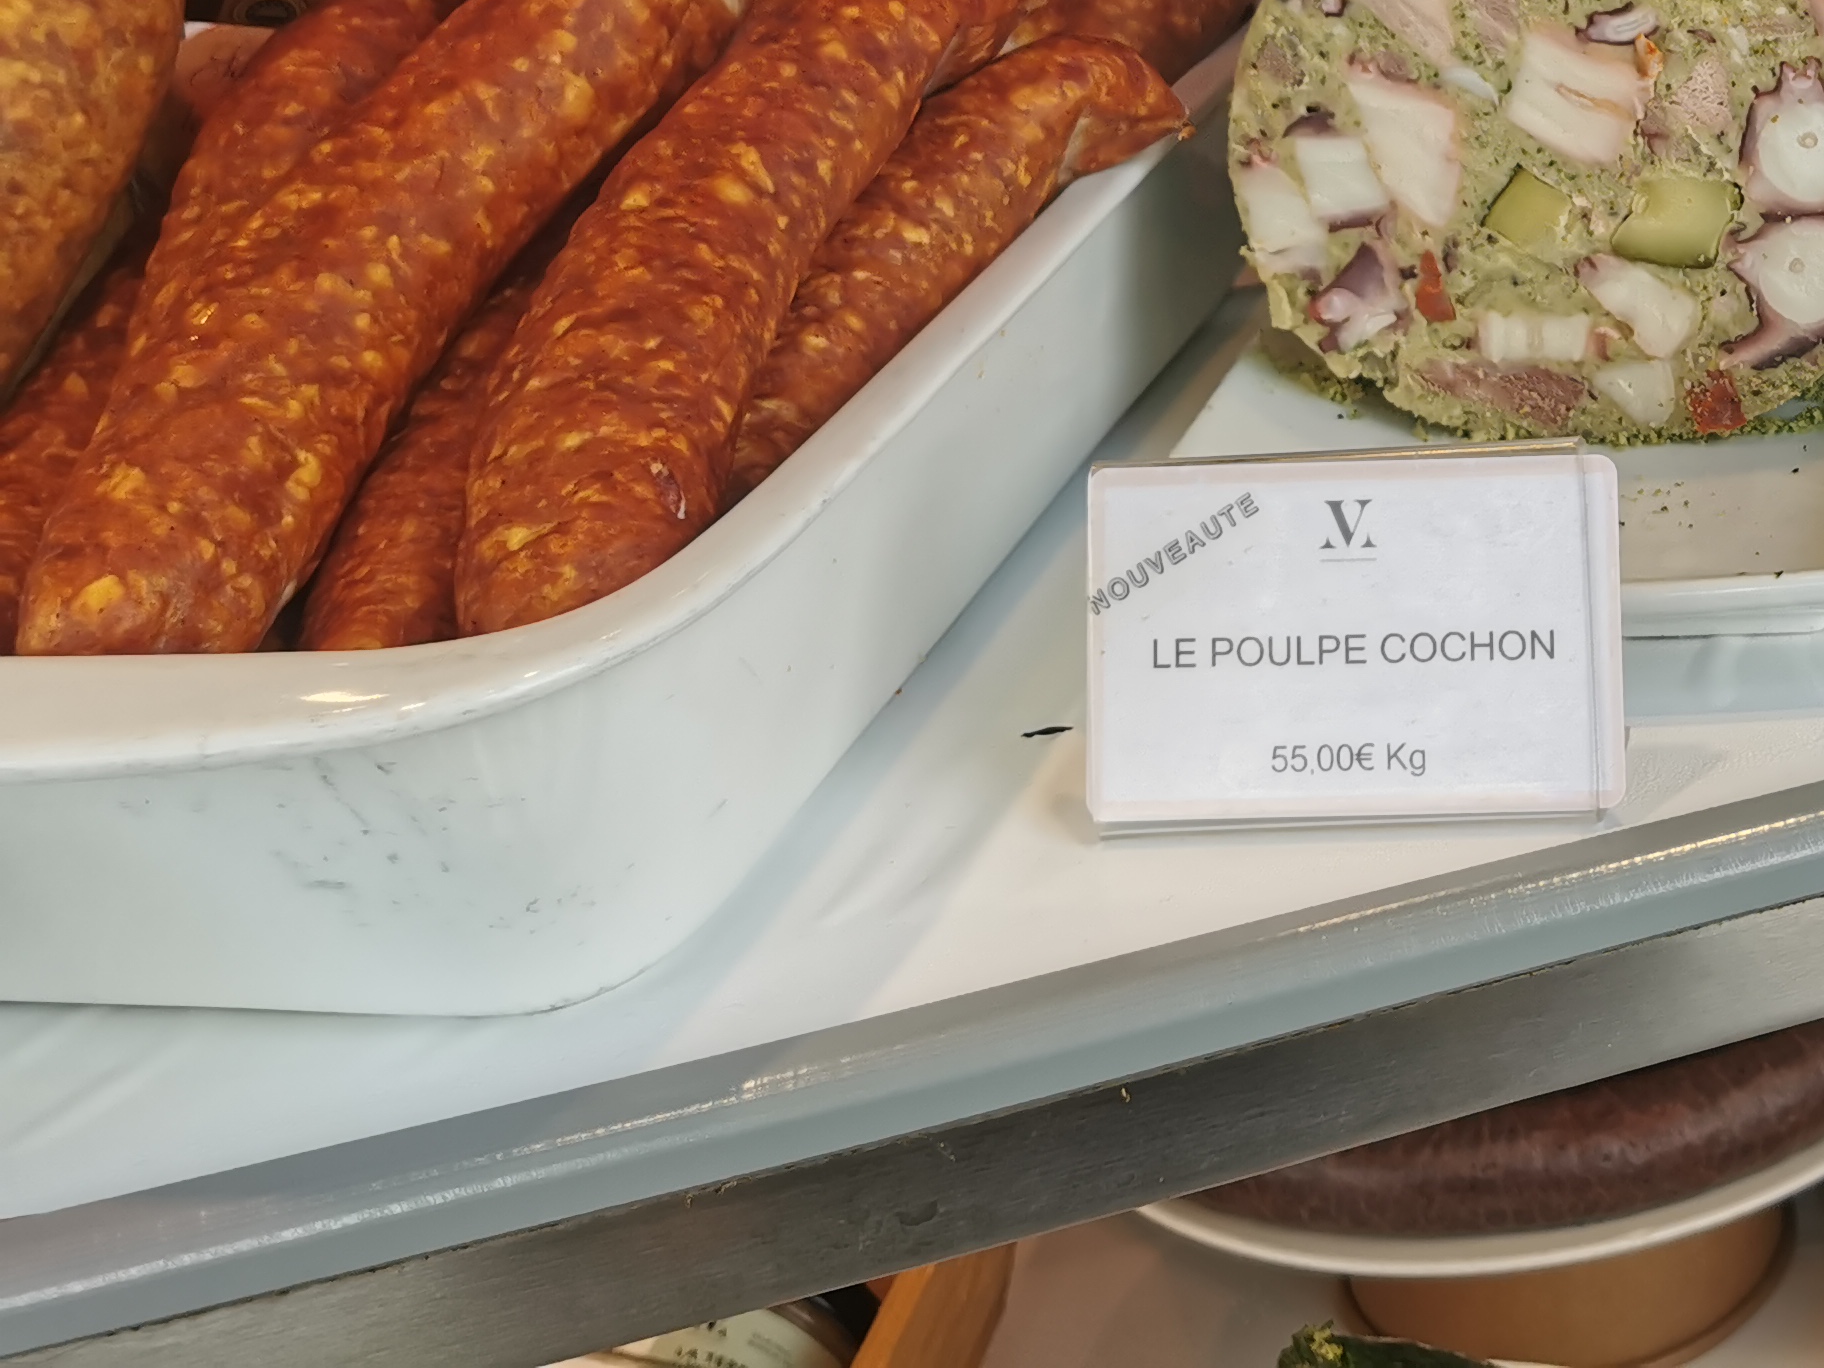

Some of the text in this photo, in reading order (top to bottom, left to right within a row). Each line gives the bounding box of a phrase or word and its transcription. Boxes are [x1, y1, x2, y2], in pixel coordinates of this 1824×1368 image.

[1088, 492, 1260, 616] NOUVEAUTE
[1152, 628, 1556, 669] LE POULPE COCHON
[1270, 741, 1427, 777] 55,00€ Kg
